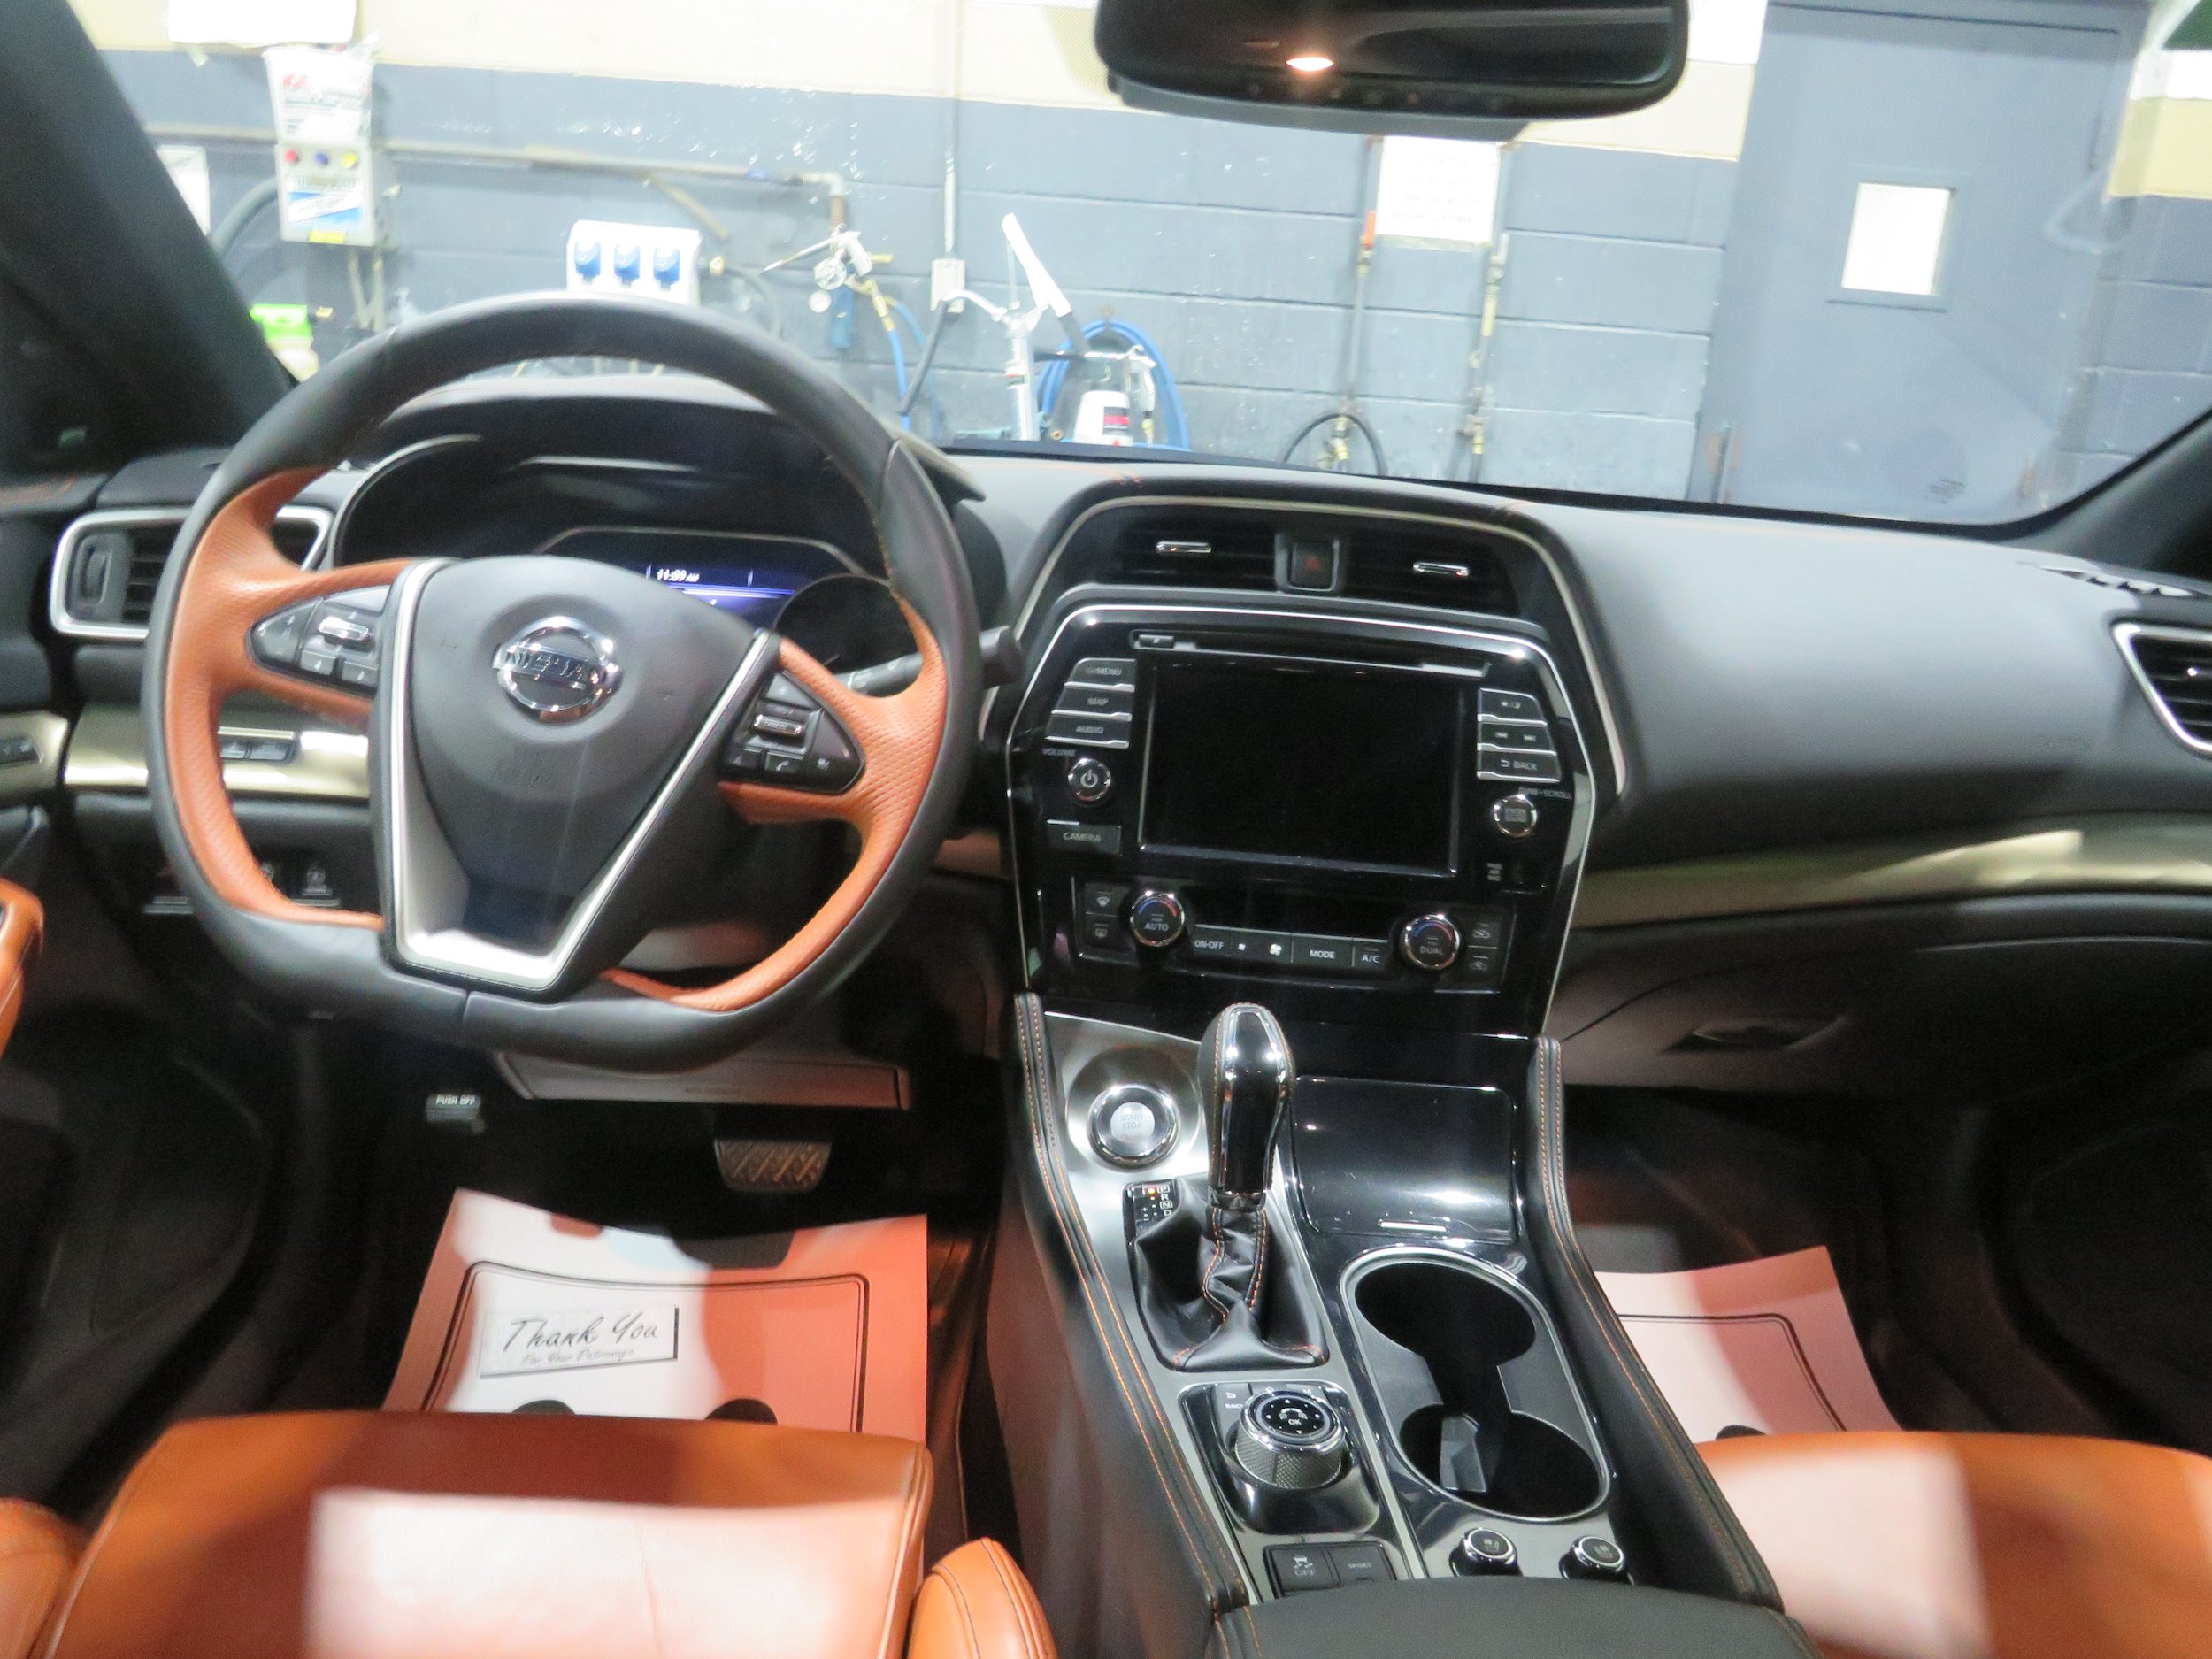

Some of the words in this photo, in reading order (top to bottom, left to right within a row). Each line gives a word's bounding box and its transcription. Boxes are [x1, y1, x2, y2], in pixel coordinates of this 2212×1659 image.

[1144, 922, 1169, 932] AUTO
[1309, 949, 1335, 959] MODE
[1419, 945, 1444, 956] DUAL
[1361, 954, 1379, 964] A/C
[436, 1094, 458, 1105] PUSH
[459, 1094, 475, 1106] OFF
[503, 1315, 604, 1353] Thank
[611, 1310, 657, 1344] You
